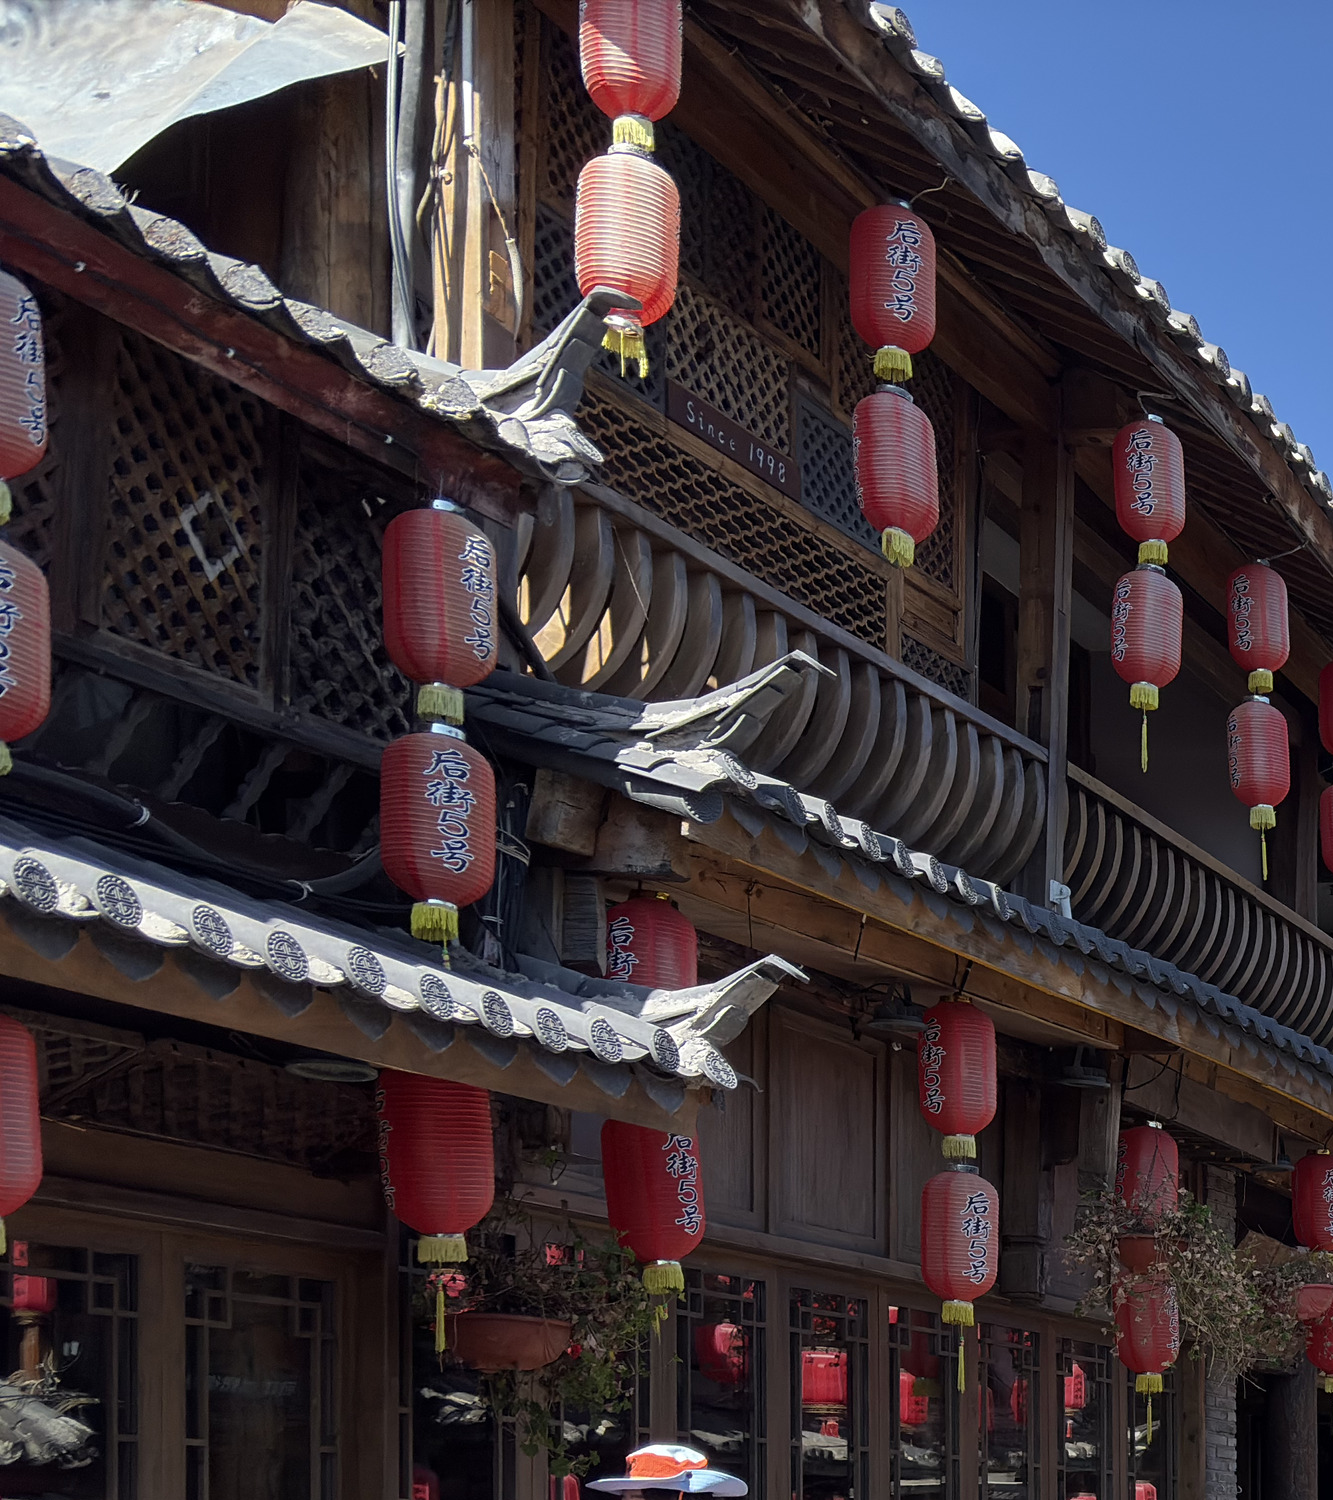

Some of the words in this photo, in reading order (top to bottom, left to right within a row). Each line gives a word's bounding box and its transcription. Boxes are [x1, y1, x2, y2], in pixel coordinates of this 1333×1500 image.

[884, 219, 923, 322] 后街5号
[686, 401, 736, 451] Since
[749, 442, 786, 483] 1998
[1125, 428, 1158, 515] 后街5号
[459, 535, 495, 661] 后街5号
[1111, 579, 1133, 662] 后街5号
[1231, 574, 1253, 650] 后街5号
[423, 749, 476, 874] 后街5号
[606, 917, 639, 982] 后街
[920, 1018, 946, 1114] 后街5号
[960, 1192, 992, 1285] 后街5号
